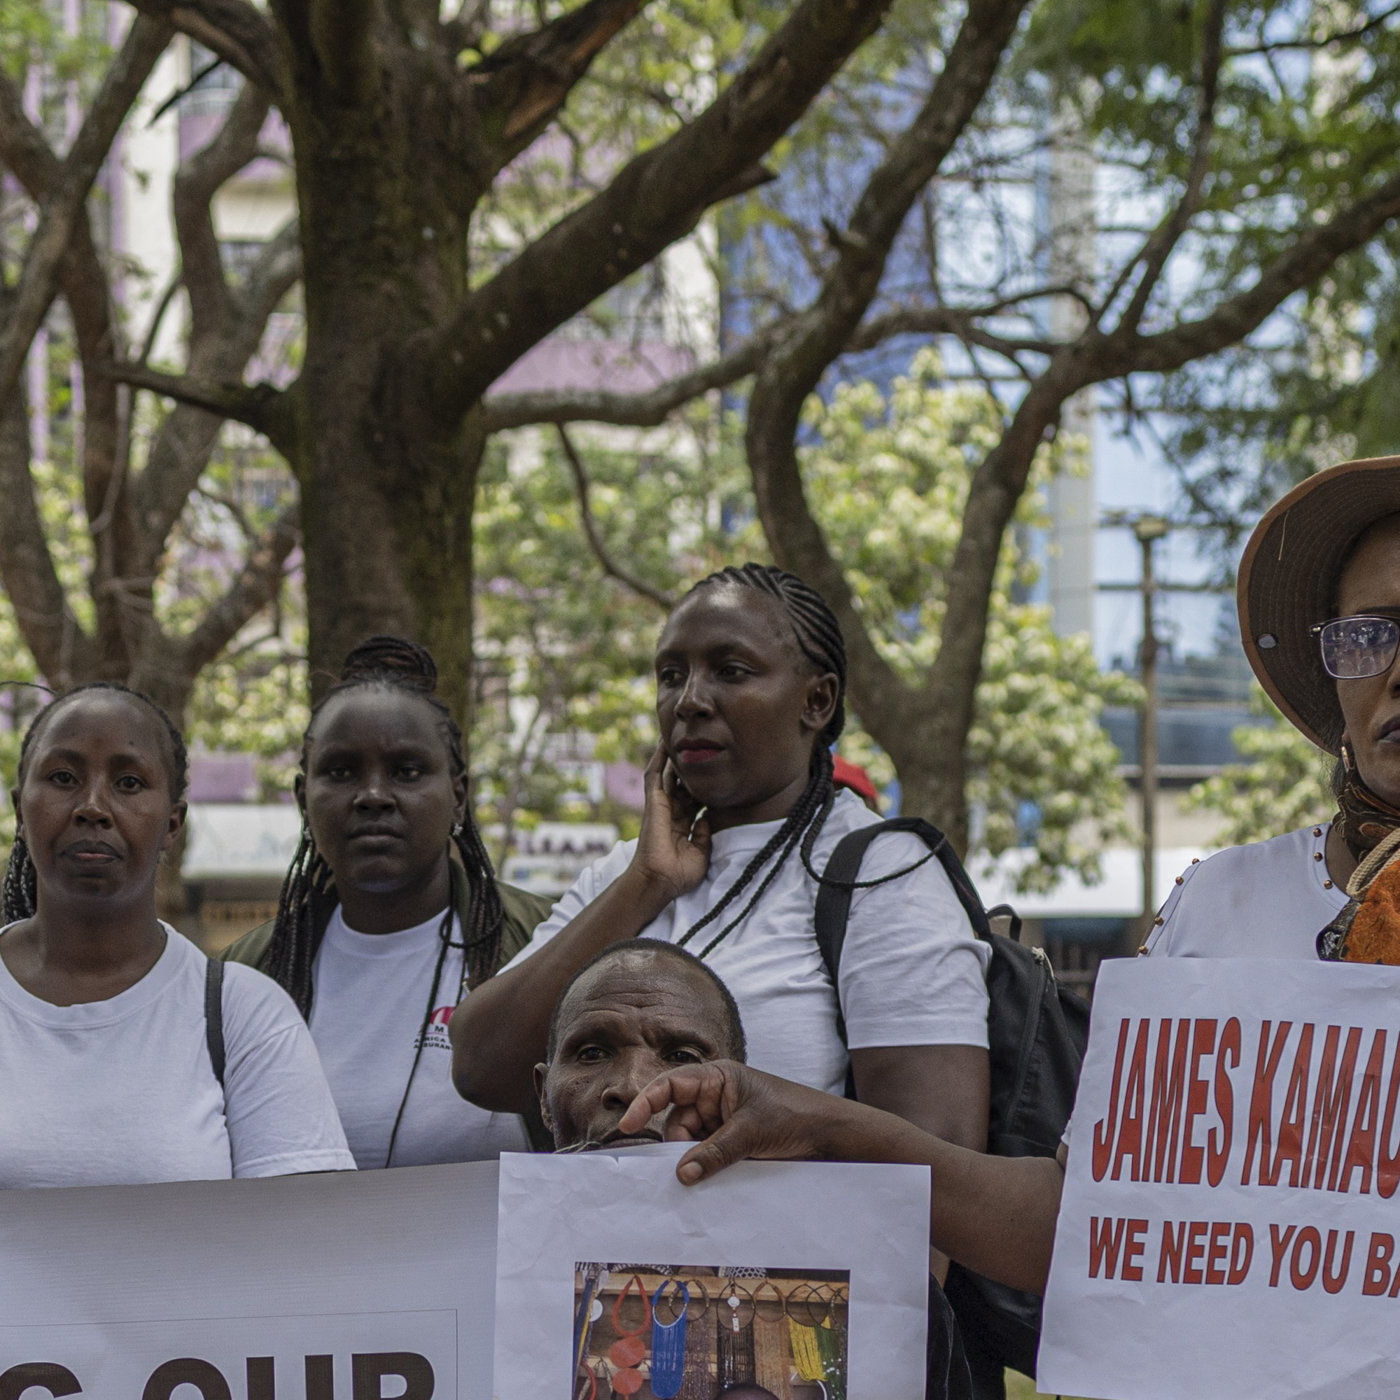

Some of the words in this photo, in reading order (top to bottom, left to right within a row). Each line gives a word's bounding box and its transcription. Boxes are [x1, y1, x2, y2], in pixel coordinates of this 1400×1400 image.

[1092, 1017, 1241, 1187] JAMES
[1089, 1217, 1149, 1281] WE
[1157, 1221, 1254, 1285] NEED
[1269, 1224, 1355, 1294] YOU
